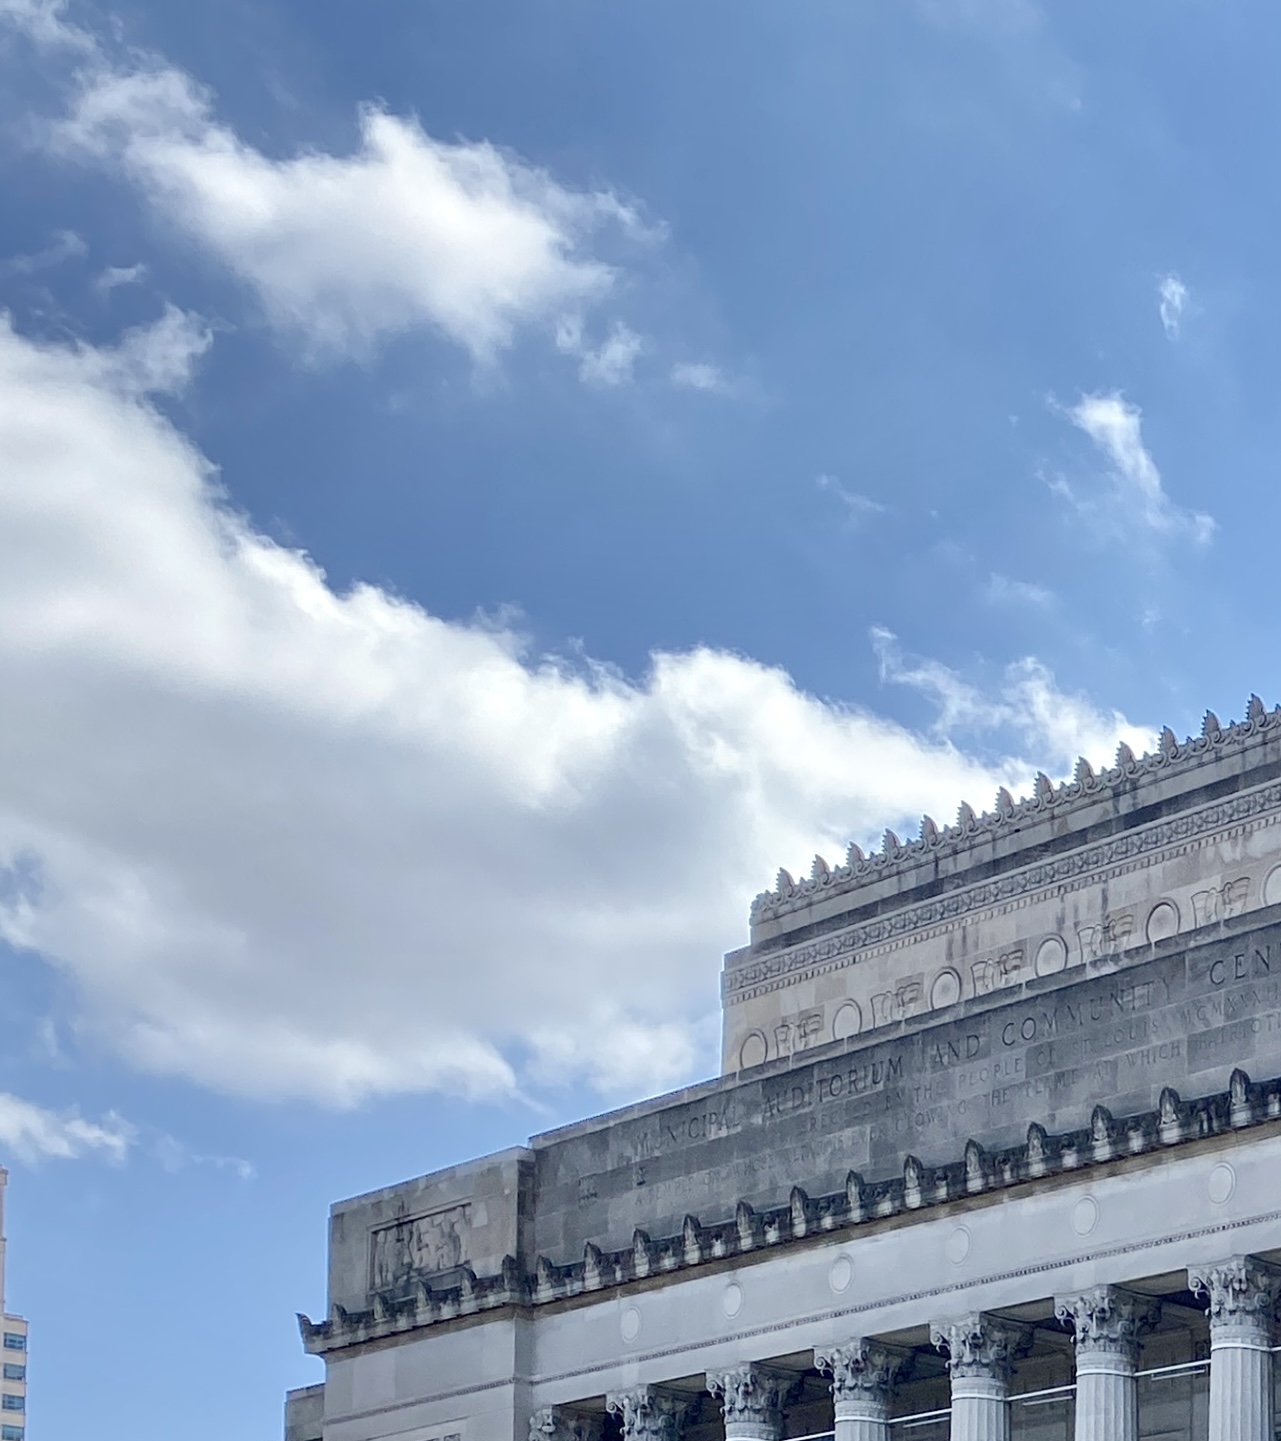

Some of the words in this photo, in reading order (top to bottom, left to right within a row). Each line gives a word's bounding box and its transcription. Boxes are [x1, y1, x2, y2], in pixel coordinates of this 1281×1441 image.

[1105, 1019, 1158, 1047] LOUIS
[635, 1105, 741, 1154] MUNICIPAL
[763, 1056, 904, 1118] AUDITORIUM
[934, 1034, 980, 1065] AND
[1001, 975, 1176, 1046] COMMUNITY
[1127, 1037, 1181, 1066] WHICH
